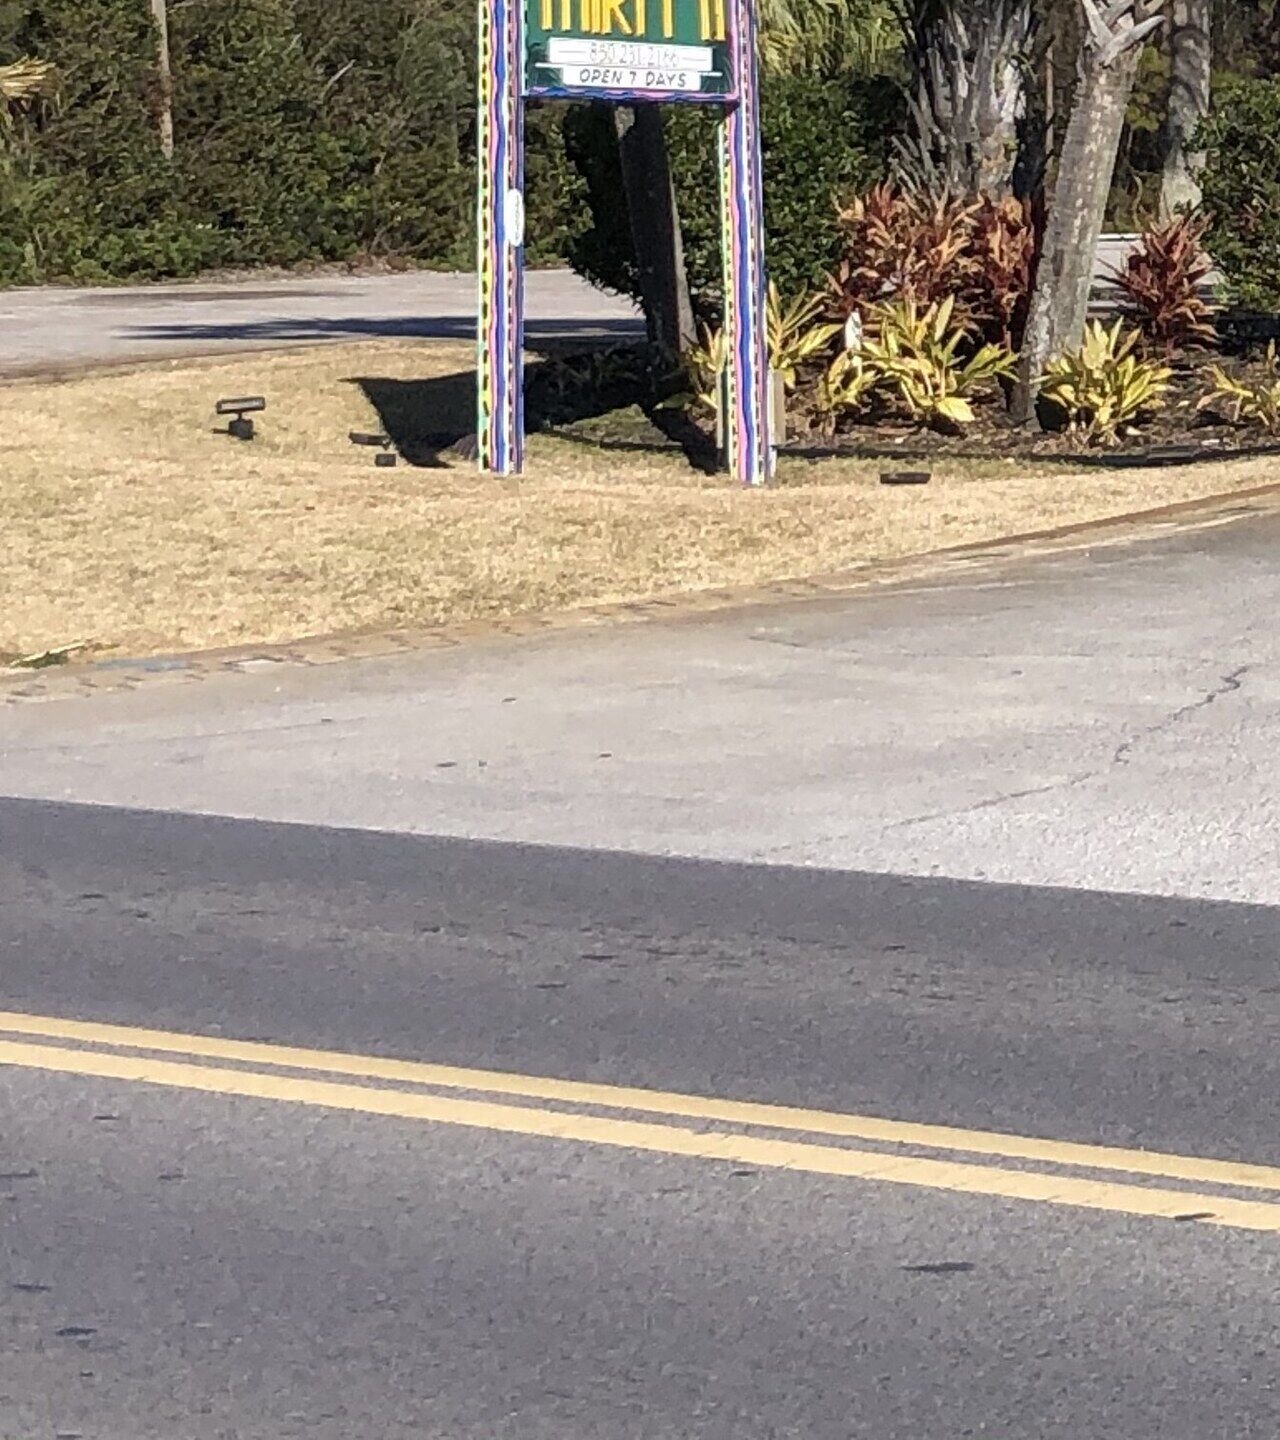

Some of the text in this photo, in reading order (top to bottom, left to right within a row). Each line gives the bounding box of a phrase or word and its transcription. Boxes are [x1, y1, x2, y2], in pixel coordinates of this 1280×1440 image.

[579, 68, 687, 88] OPEN 7 DAYS
